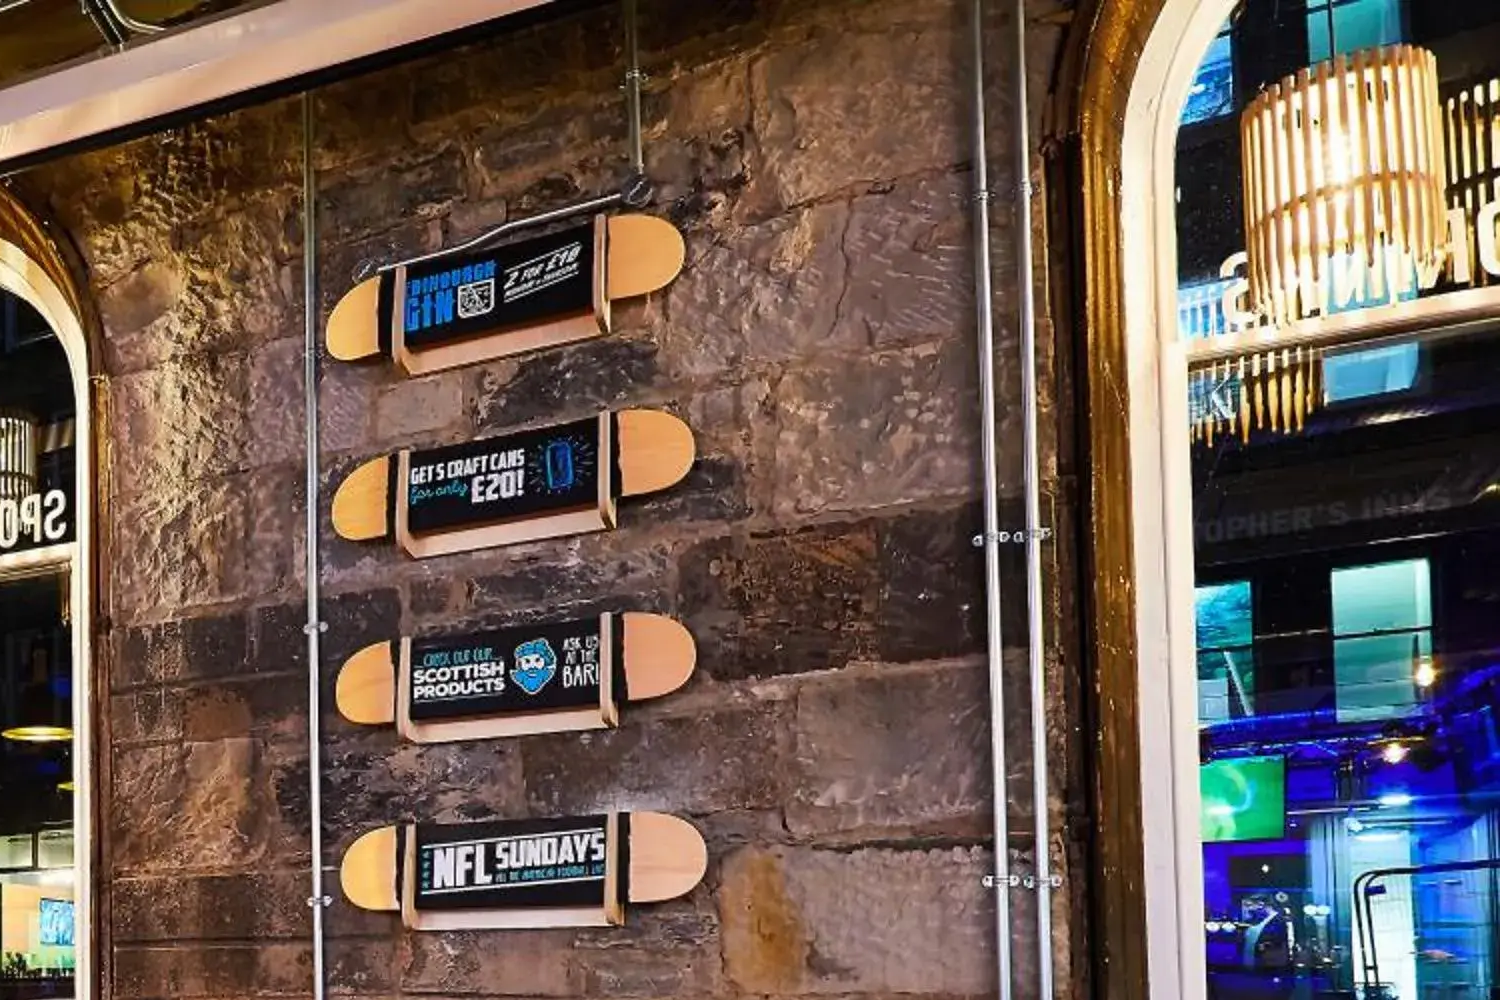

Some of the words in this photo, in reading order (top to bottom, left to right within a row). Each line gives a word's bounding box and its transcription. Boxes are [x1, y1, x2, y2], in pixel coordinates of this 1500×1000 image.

[407, 259, 497, 296] DINBURGH
[503, 270, 519, 290] 2
[521, 267, 544, 283] FOR
[405, 289, 454, 332] GIN
[411, 464, 433, 485] GET
[447, 455, 488, 478] DRAFT
[489, 448, 525, 471] CANS
[562, 637, 581, 651] ASK
[565, 651, 576, 665] AT
[581, 648, 596, 664] THE
[413, 661, 505, 684] SCOTTISH
[563, 662, 599, 689] BAR!
[413, 677, 505, 700] PRODUCTS
[433, 843, 492, 889] NFL
[495, 832, 605, 870] SUNDAYS
